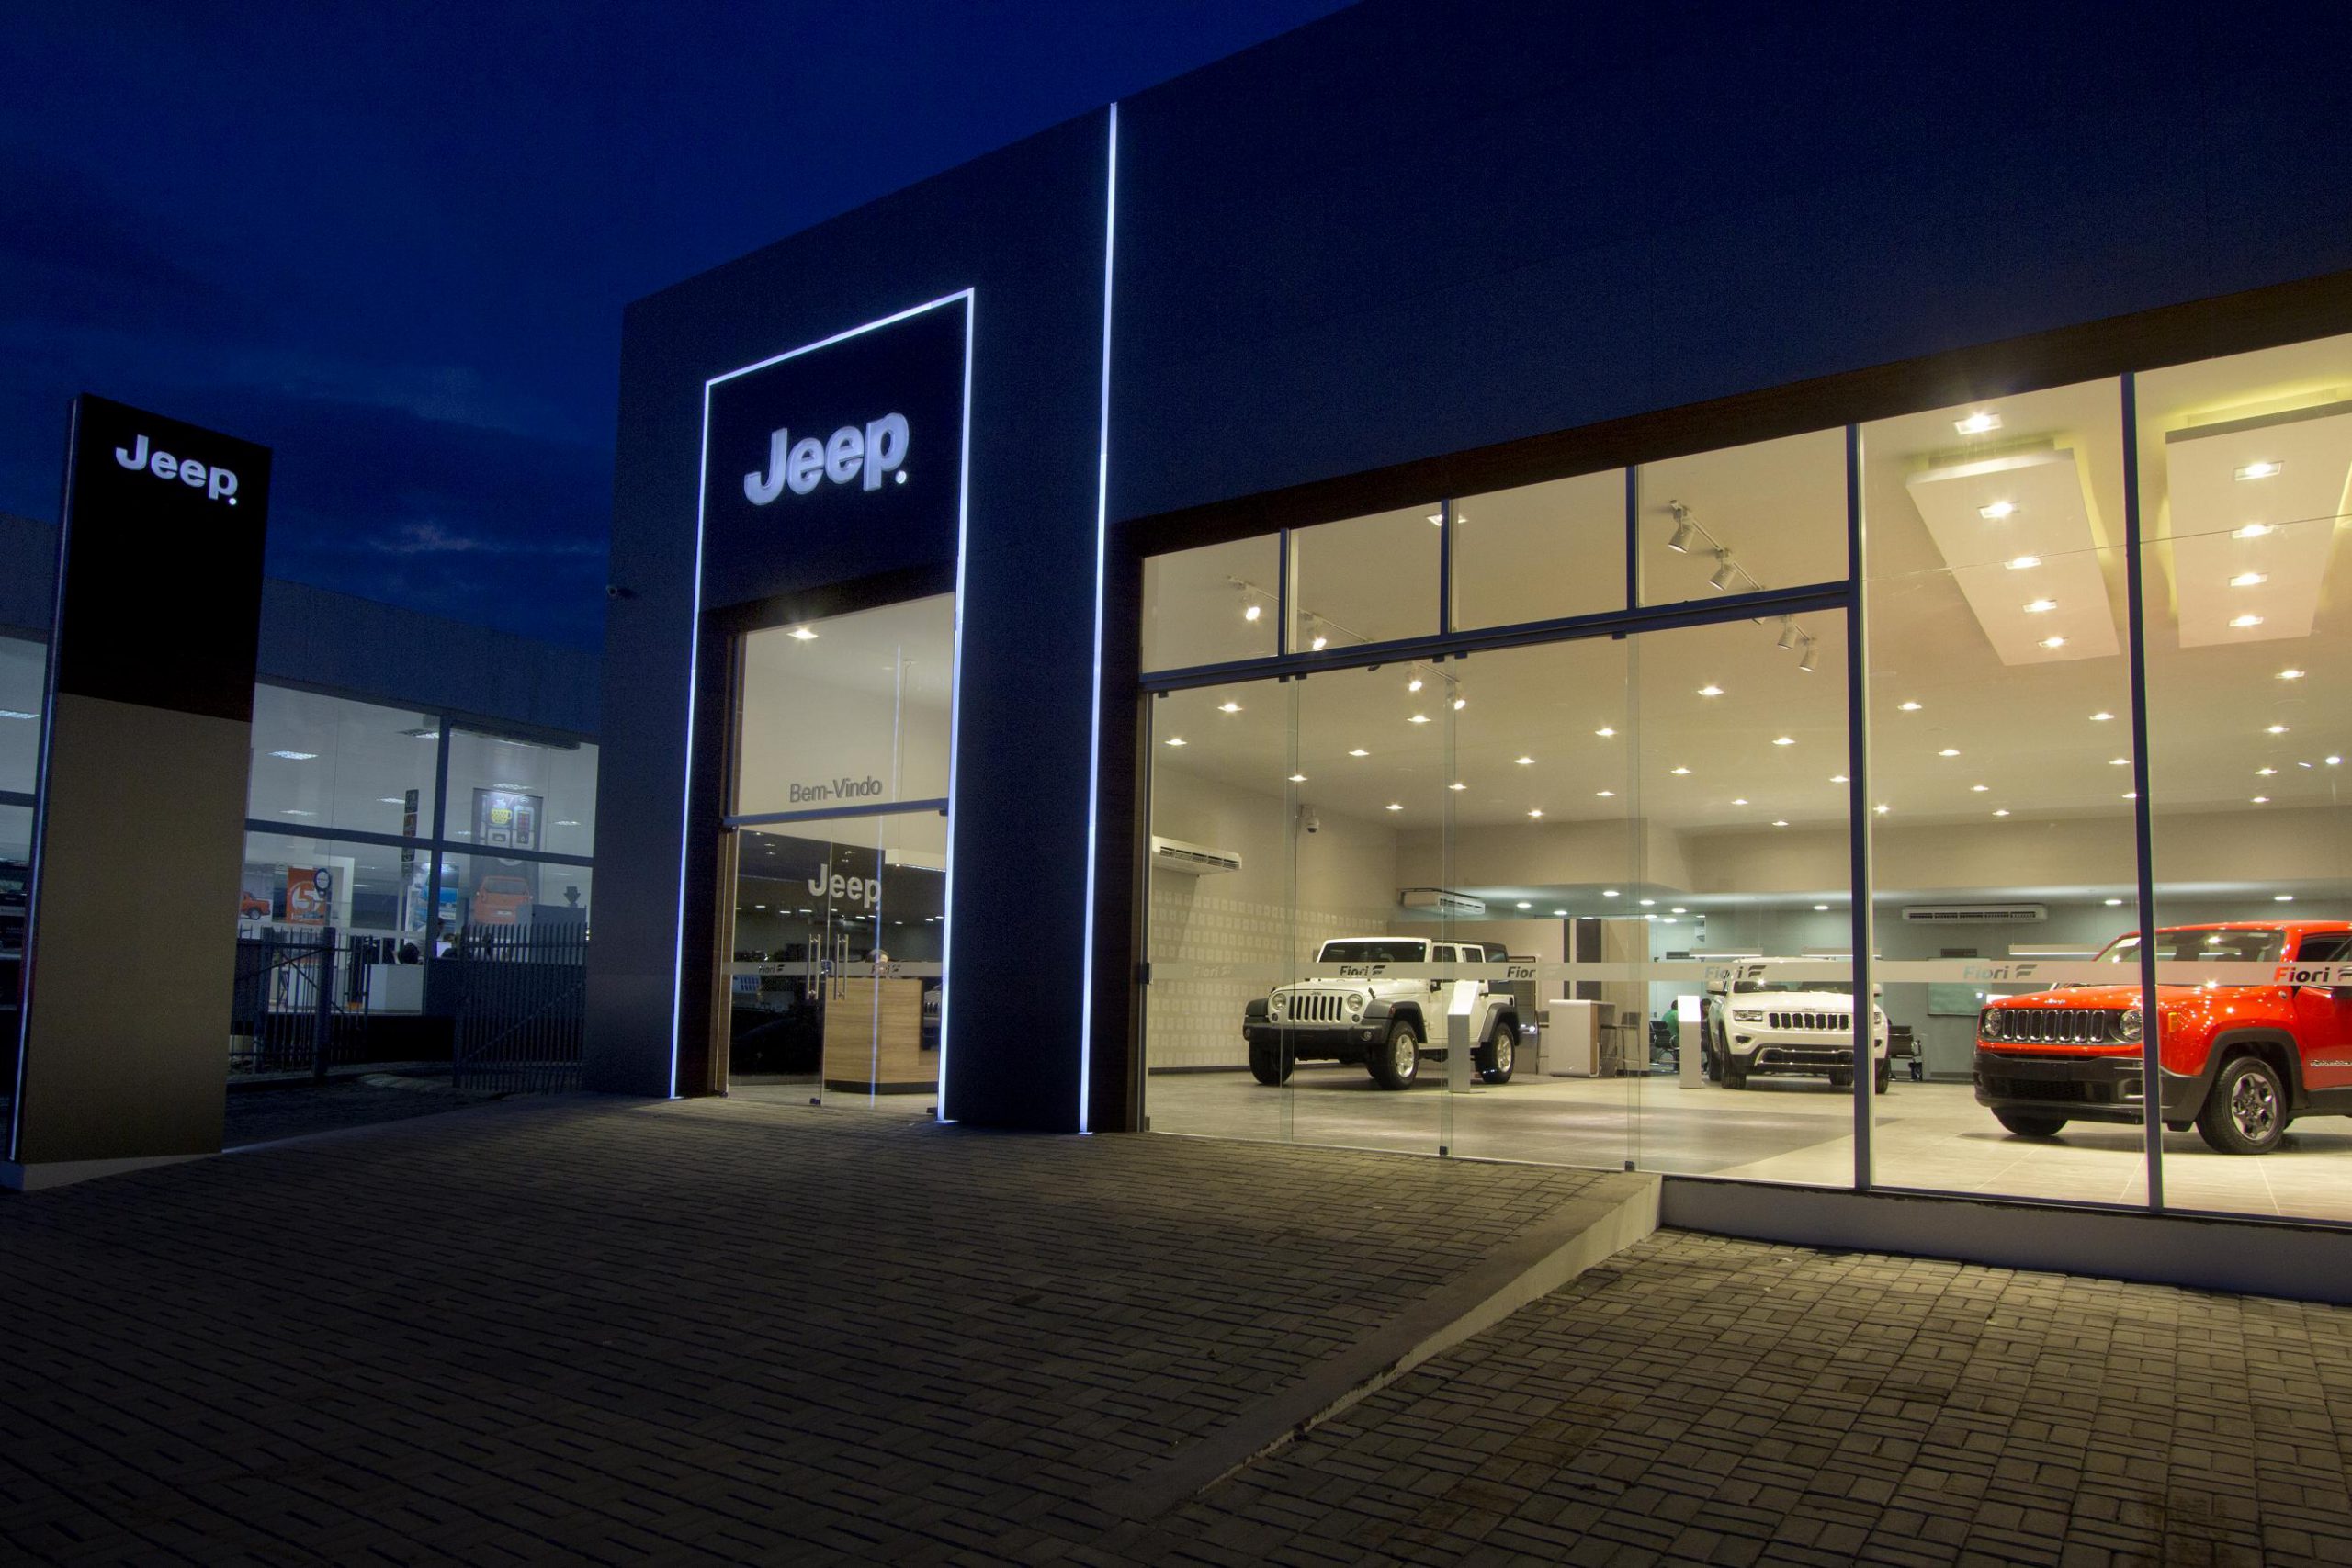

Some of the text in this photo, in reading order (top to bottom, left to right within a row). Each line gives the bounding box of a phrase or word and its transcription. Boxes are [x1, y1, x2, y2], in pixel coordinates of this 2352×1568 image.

[789, 775, 883, 803] Bem-Vindo
[1507, 966, 1537, 978] Fior
[1704, 965, 1744, 979] Fioi
[1963, 965, 2010, 979] Fiori
[2274, 967, 2331, 983] Fiori
